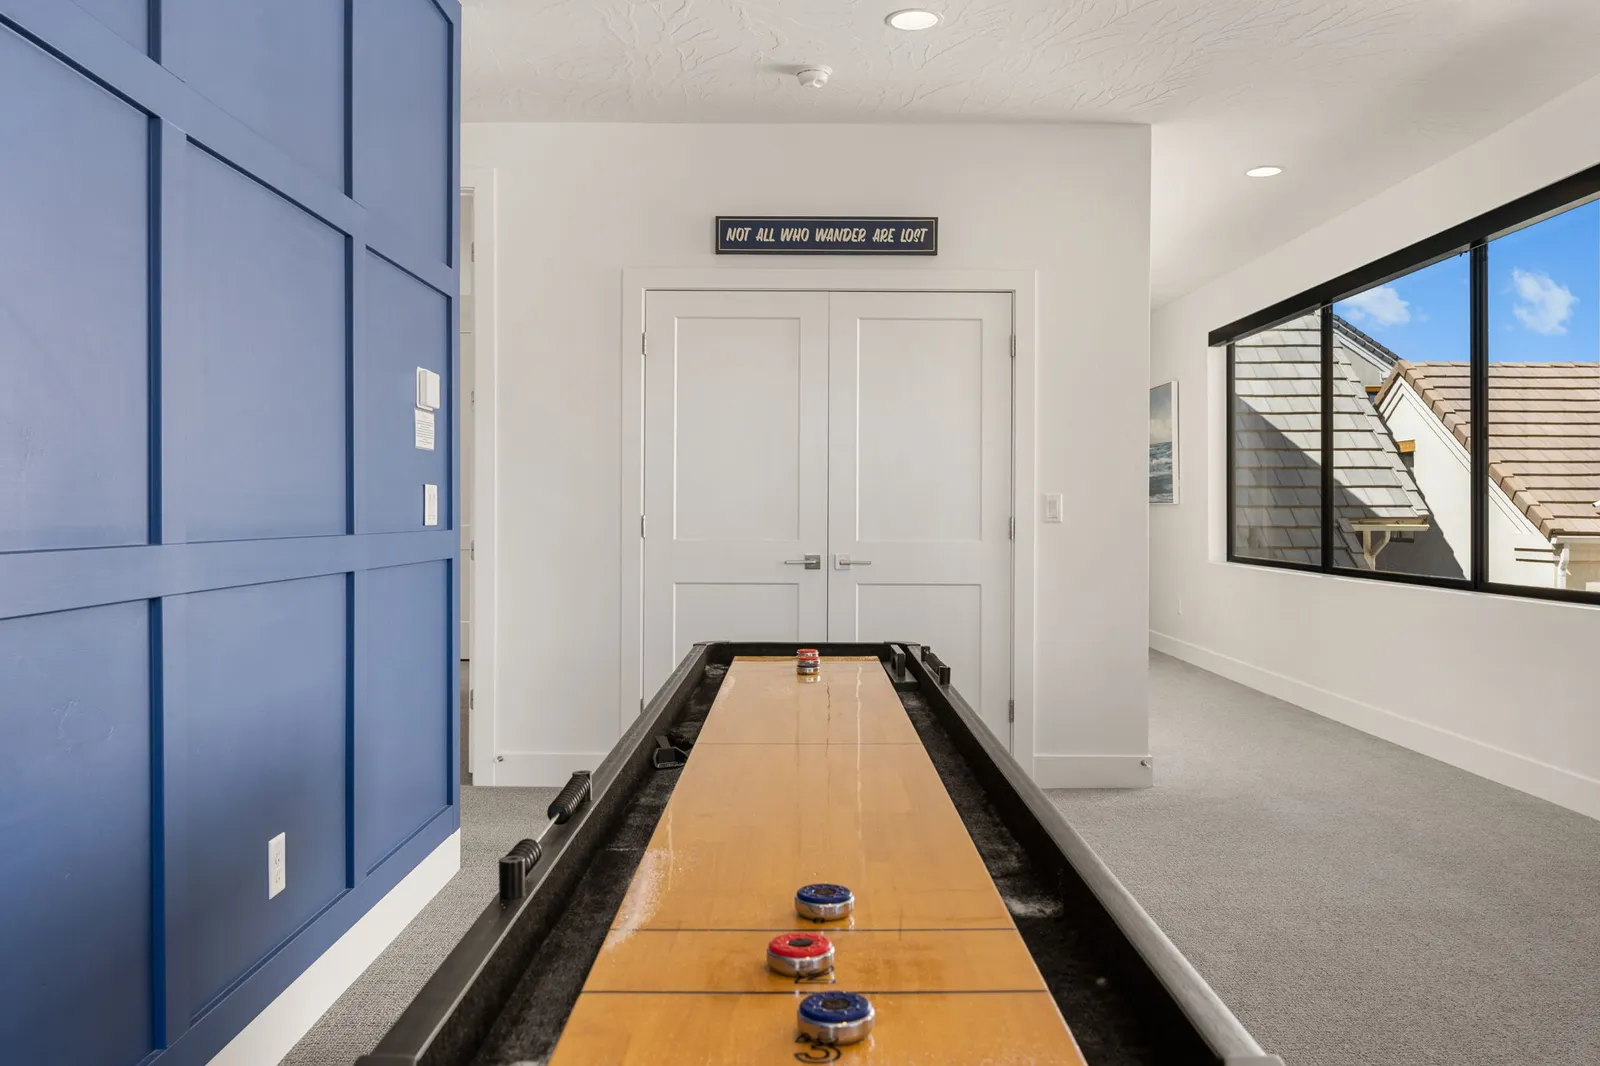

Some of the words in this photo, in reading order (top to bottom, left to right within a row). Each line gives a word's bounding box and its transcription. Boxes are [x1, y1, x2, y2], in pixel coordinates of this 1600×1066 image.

[726, 227, 751, 243] NOT
[755, 227, 775, 243] ALL
[780, 227, 809, 243] WHO
[814, 227, 866, 243] WANDER
[871, 227, 895, 243] ARE
[900, 227, 928, 243] LOST
